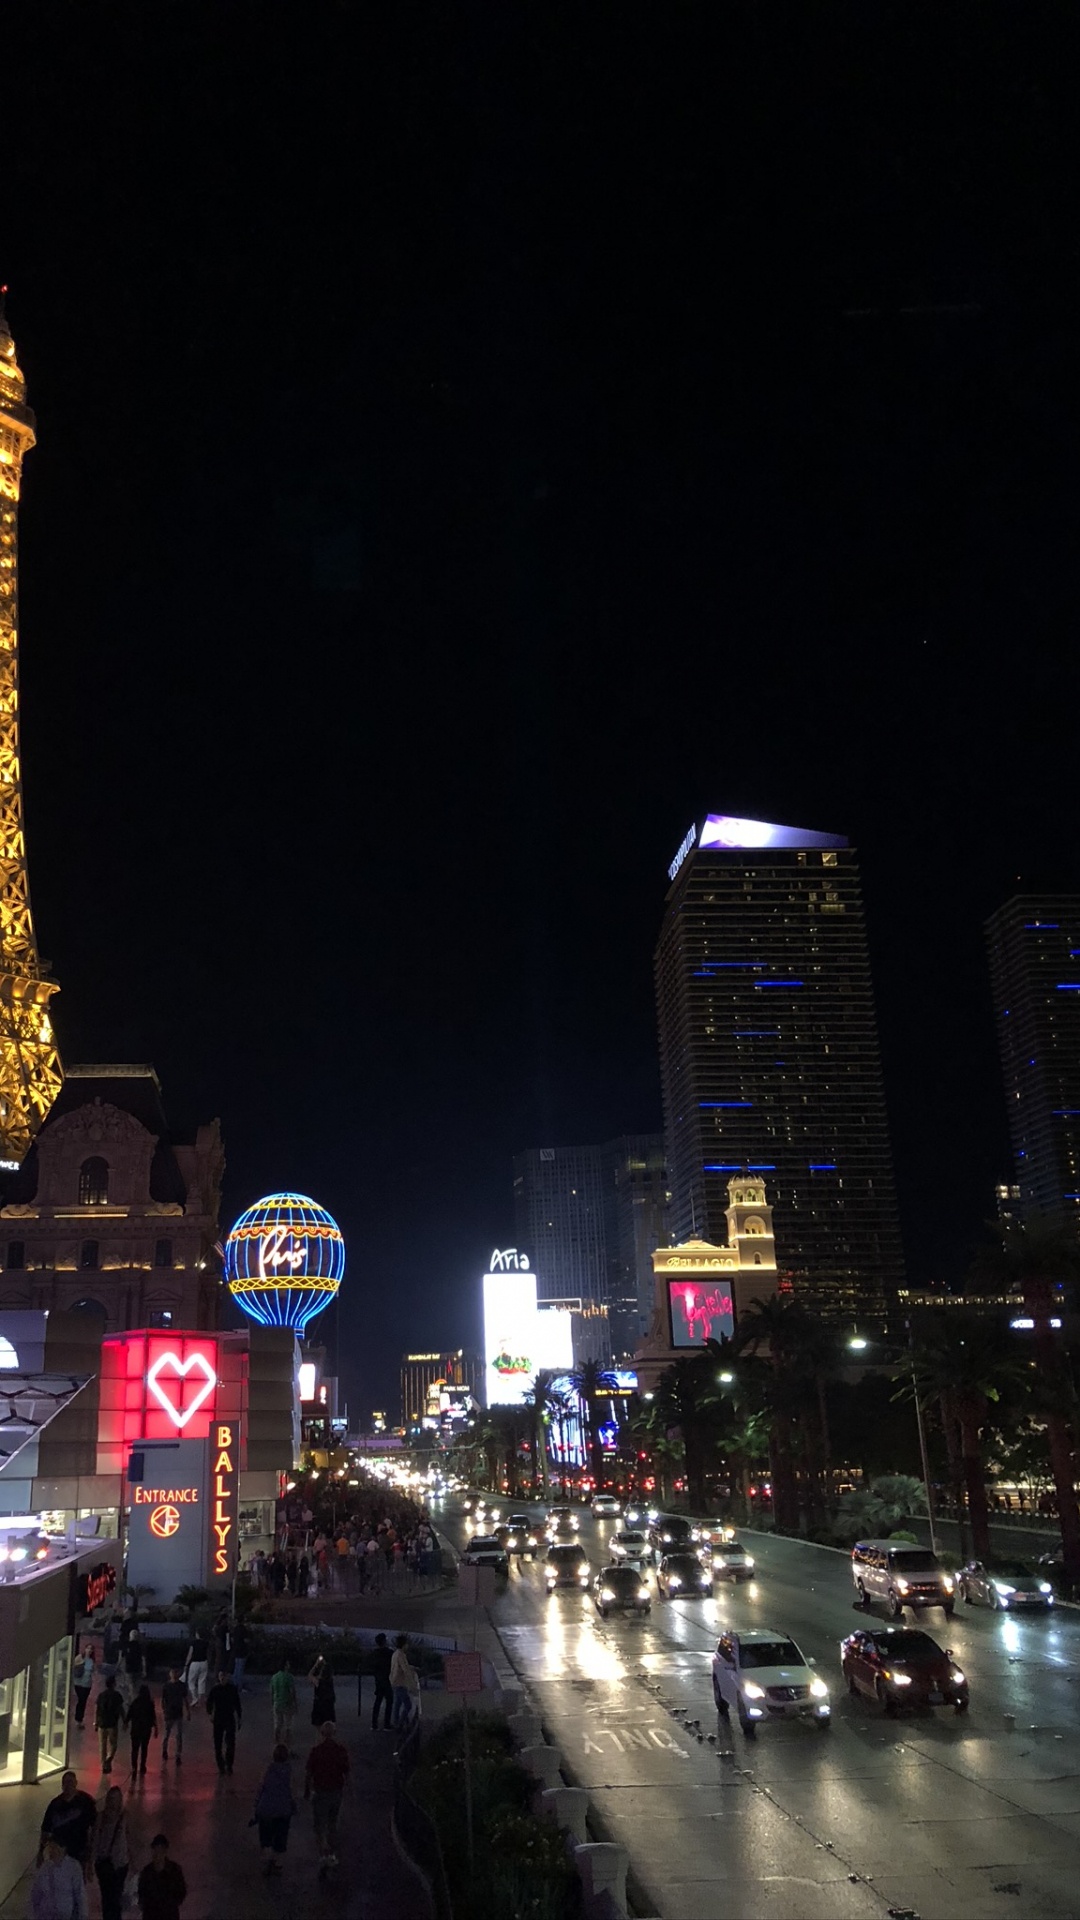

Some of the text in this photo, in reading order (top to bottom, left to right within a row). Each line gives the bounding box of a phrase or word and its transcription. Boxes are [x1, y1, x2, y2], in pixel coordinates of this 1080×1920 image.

[259, 1225, 308, 1282] Paris
[490, 1248, 530, 1272] Aria
[666, 1256, 734, 1268] BELLAGIO
[135, 1486, 199, 1503] ENTRANCE
[582, 1728, 686, 1757] ONLY
